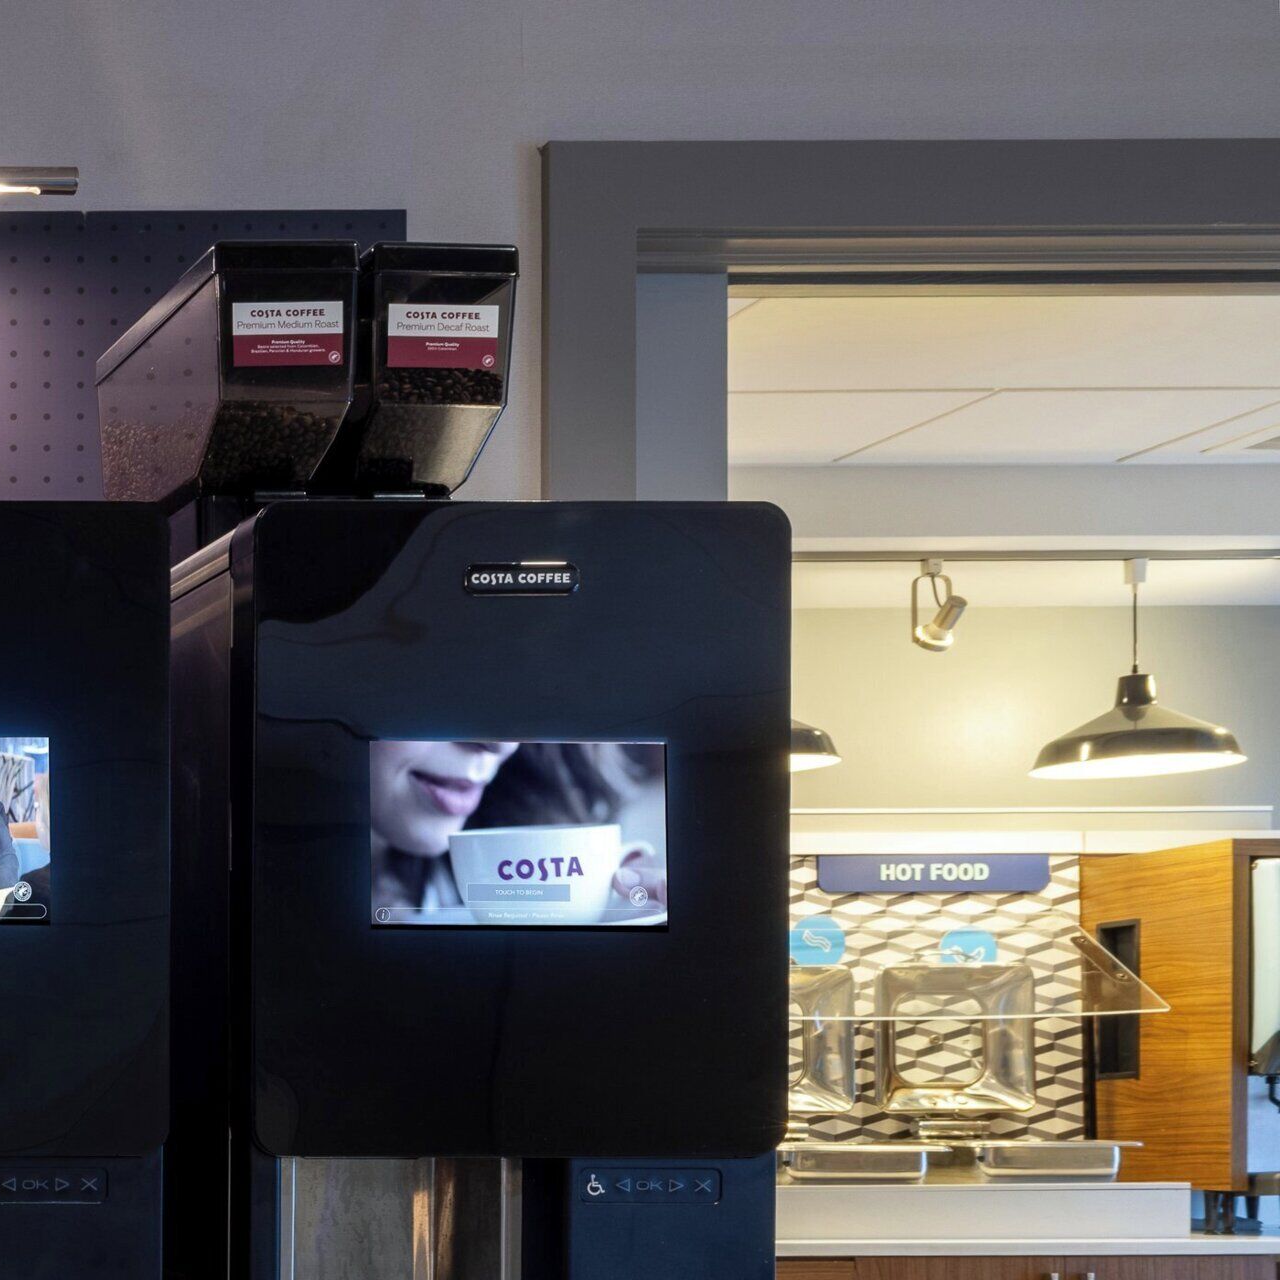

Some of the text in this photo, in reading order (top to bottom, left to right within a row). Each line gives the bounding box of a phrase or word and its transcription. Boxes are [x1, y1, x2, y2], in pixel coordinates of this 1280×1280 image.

[250, 309, 326, 318] COSTA COFFEE
[406, 311, 481, 320] COSTA COFFEE
[237, 320, 339, 330] Premium Medium Roast
[396, 322, 490, 332] Premium Decaf Roast
[471, 573, 571, 585] COSTA COFFEE
[497, 856, 584, 882] COSTA
[880, 863, 990, 881] HOT FOOD
[22, 1180, 48, 1190] OK
[636, 1180, 663, 1190] OK
